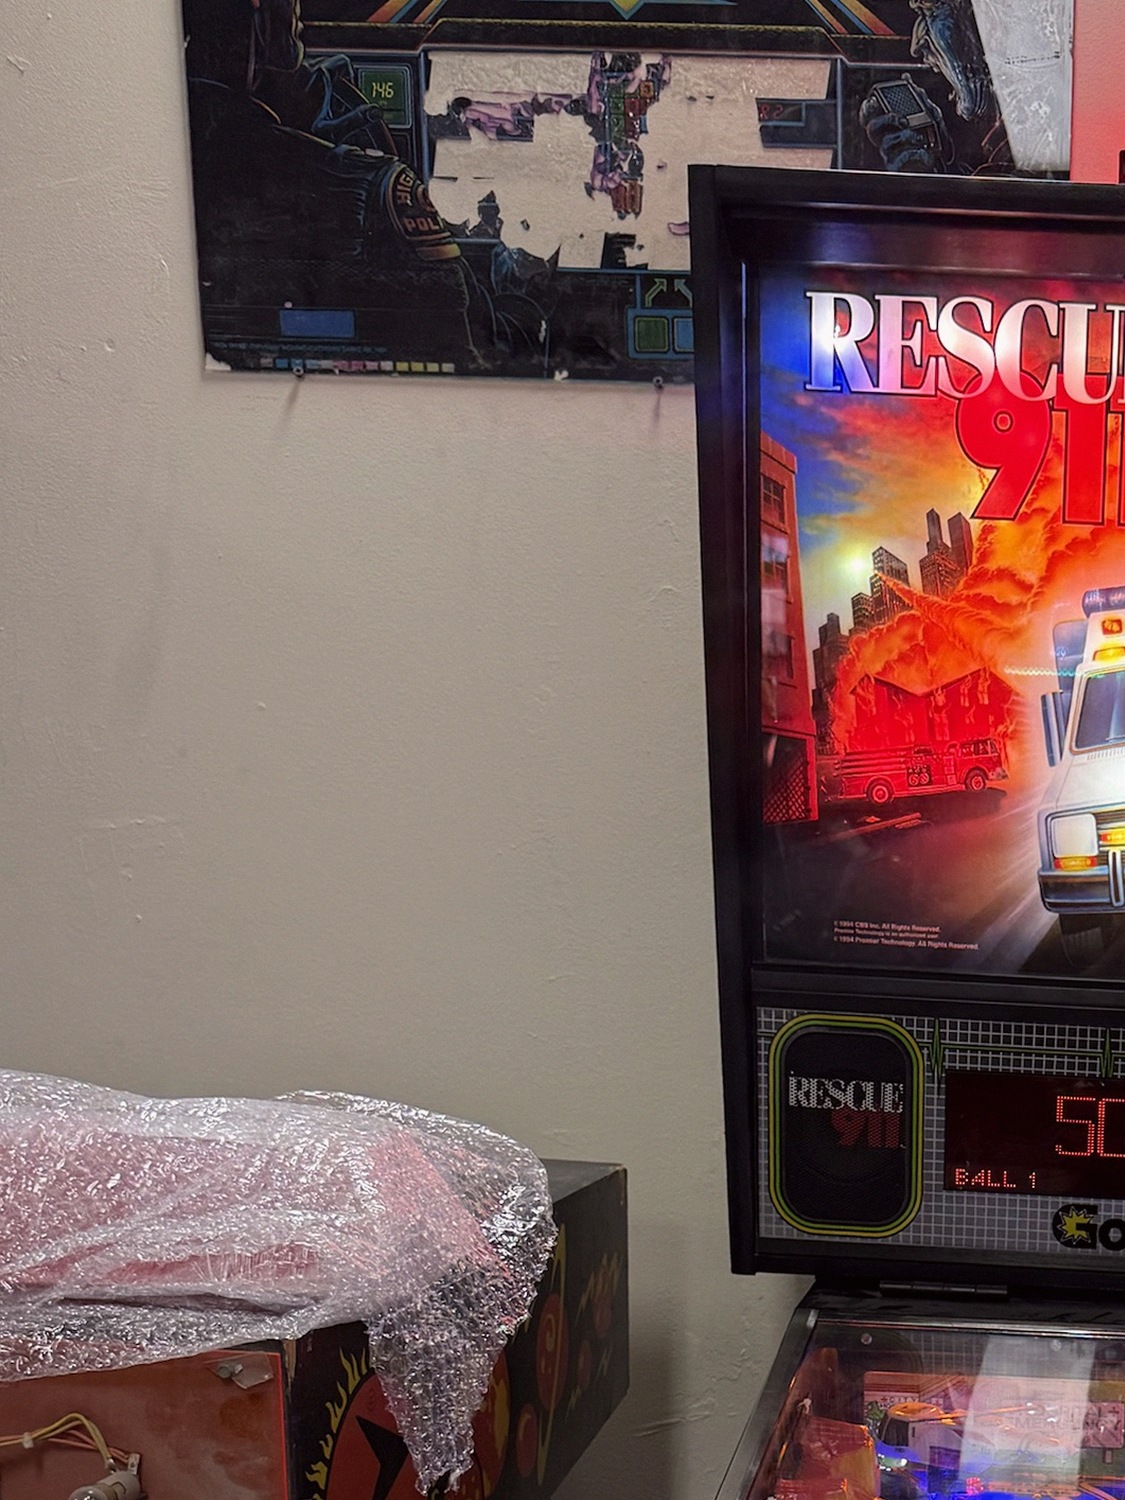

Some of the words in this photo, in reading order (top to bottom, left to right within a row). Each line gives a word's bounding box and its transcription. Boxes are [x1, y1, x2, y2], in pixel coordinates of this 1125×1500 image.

[789, 1077, 904, 1113] RESCUE
[831, 1107, 900, 1148] 911
[954, 1167, 1017, 1190] BALL
[1028, 1171, 1037, 1189] 1
